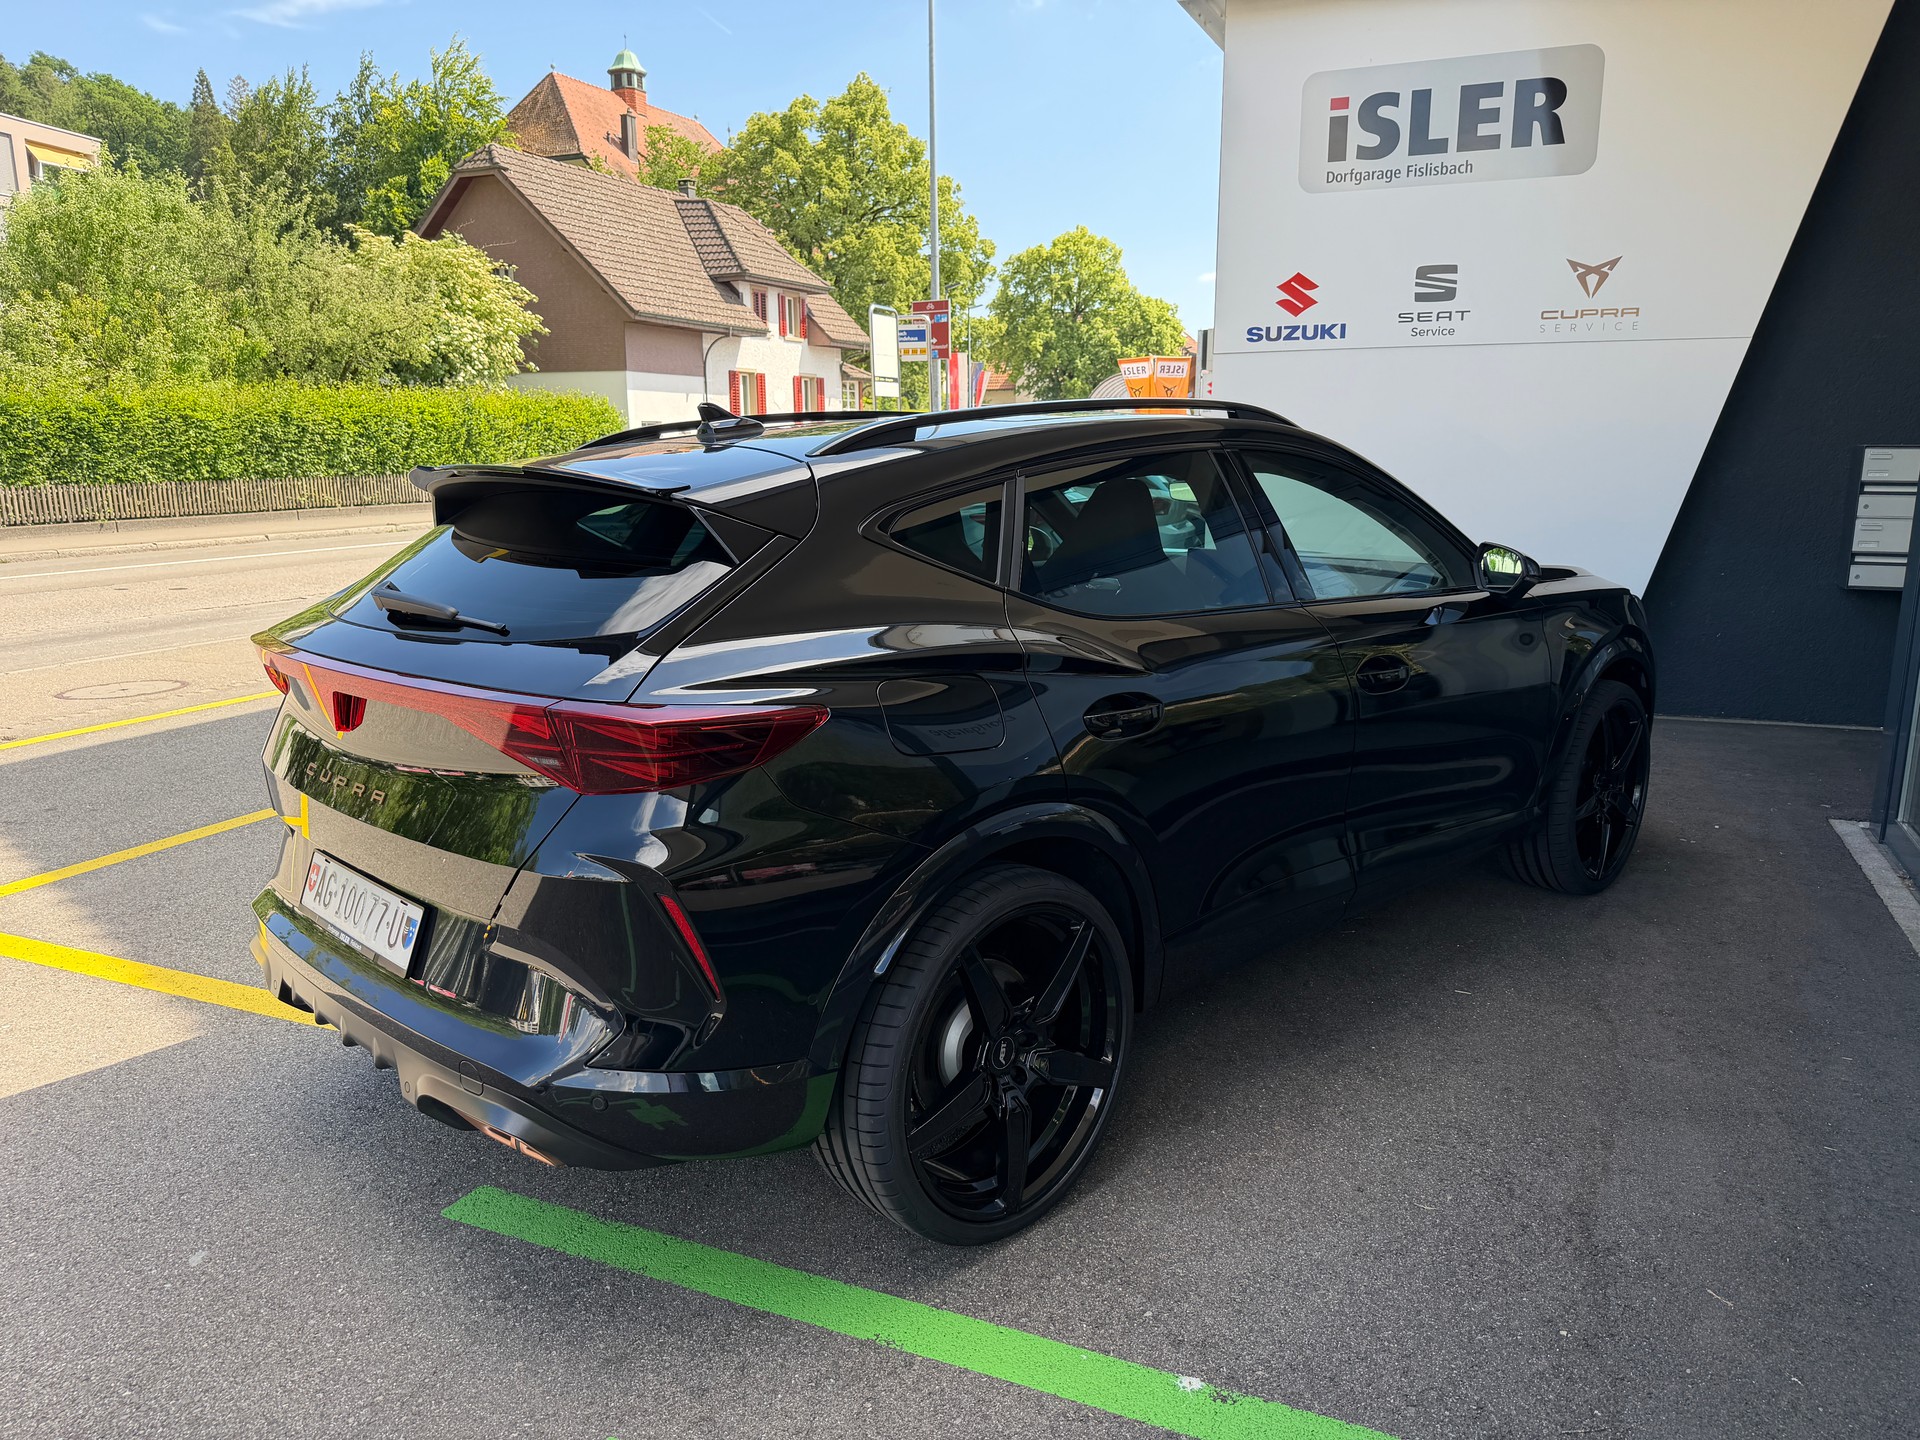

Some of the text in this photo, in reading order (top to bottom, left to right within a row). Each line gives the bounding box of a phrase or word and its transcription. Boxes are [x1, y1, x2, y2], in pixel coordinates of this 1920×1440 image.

[1325, 160, 1474, 186] Dorfgarage Fislisbach
[1398, 310, 1471, 324] SEAT
[1540, 307, 1640, 320] CUPRA
[1246, 323, 1347, 343] SUZUKI
[1410, 326, 1456, 338] Service
[1539, 321, 1640, 334] SERVICE
[306, 761, 386, 805] CUPRA
